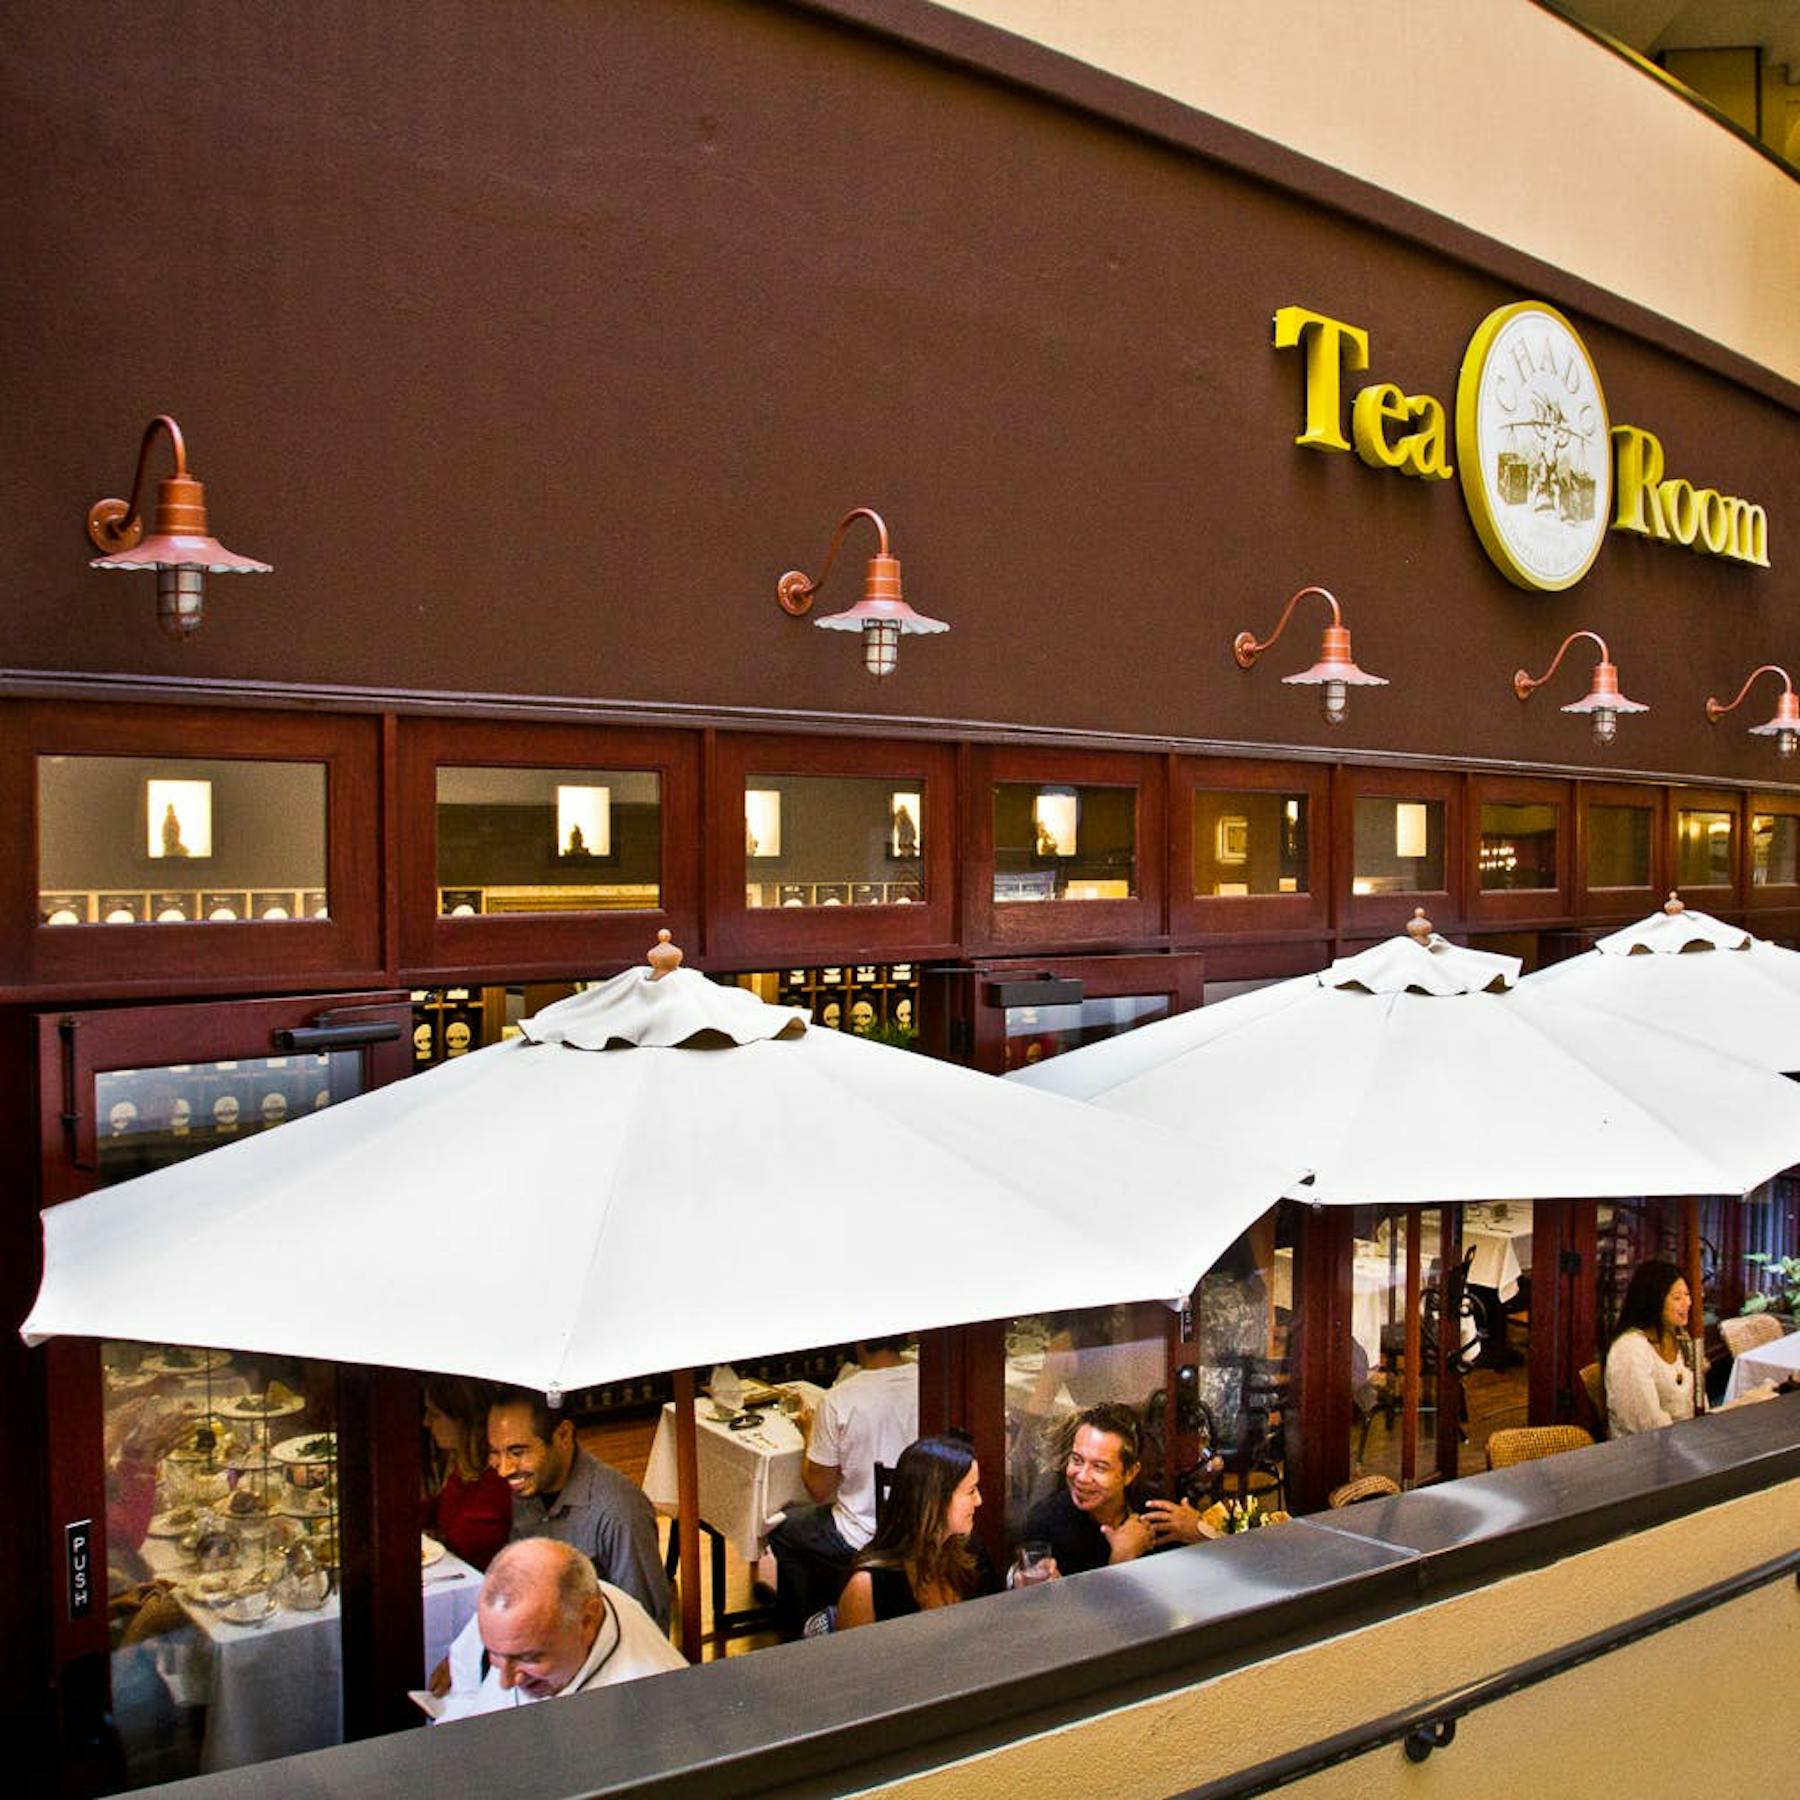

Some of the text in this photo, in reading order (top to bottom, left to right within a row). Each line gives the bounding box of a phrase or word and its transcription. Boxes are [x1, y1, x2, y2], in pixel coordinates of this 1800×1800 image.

[1274, 305, 1770, 567] Tea Room
[72, 1537, 87, 1607] PUSH
